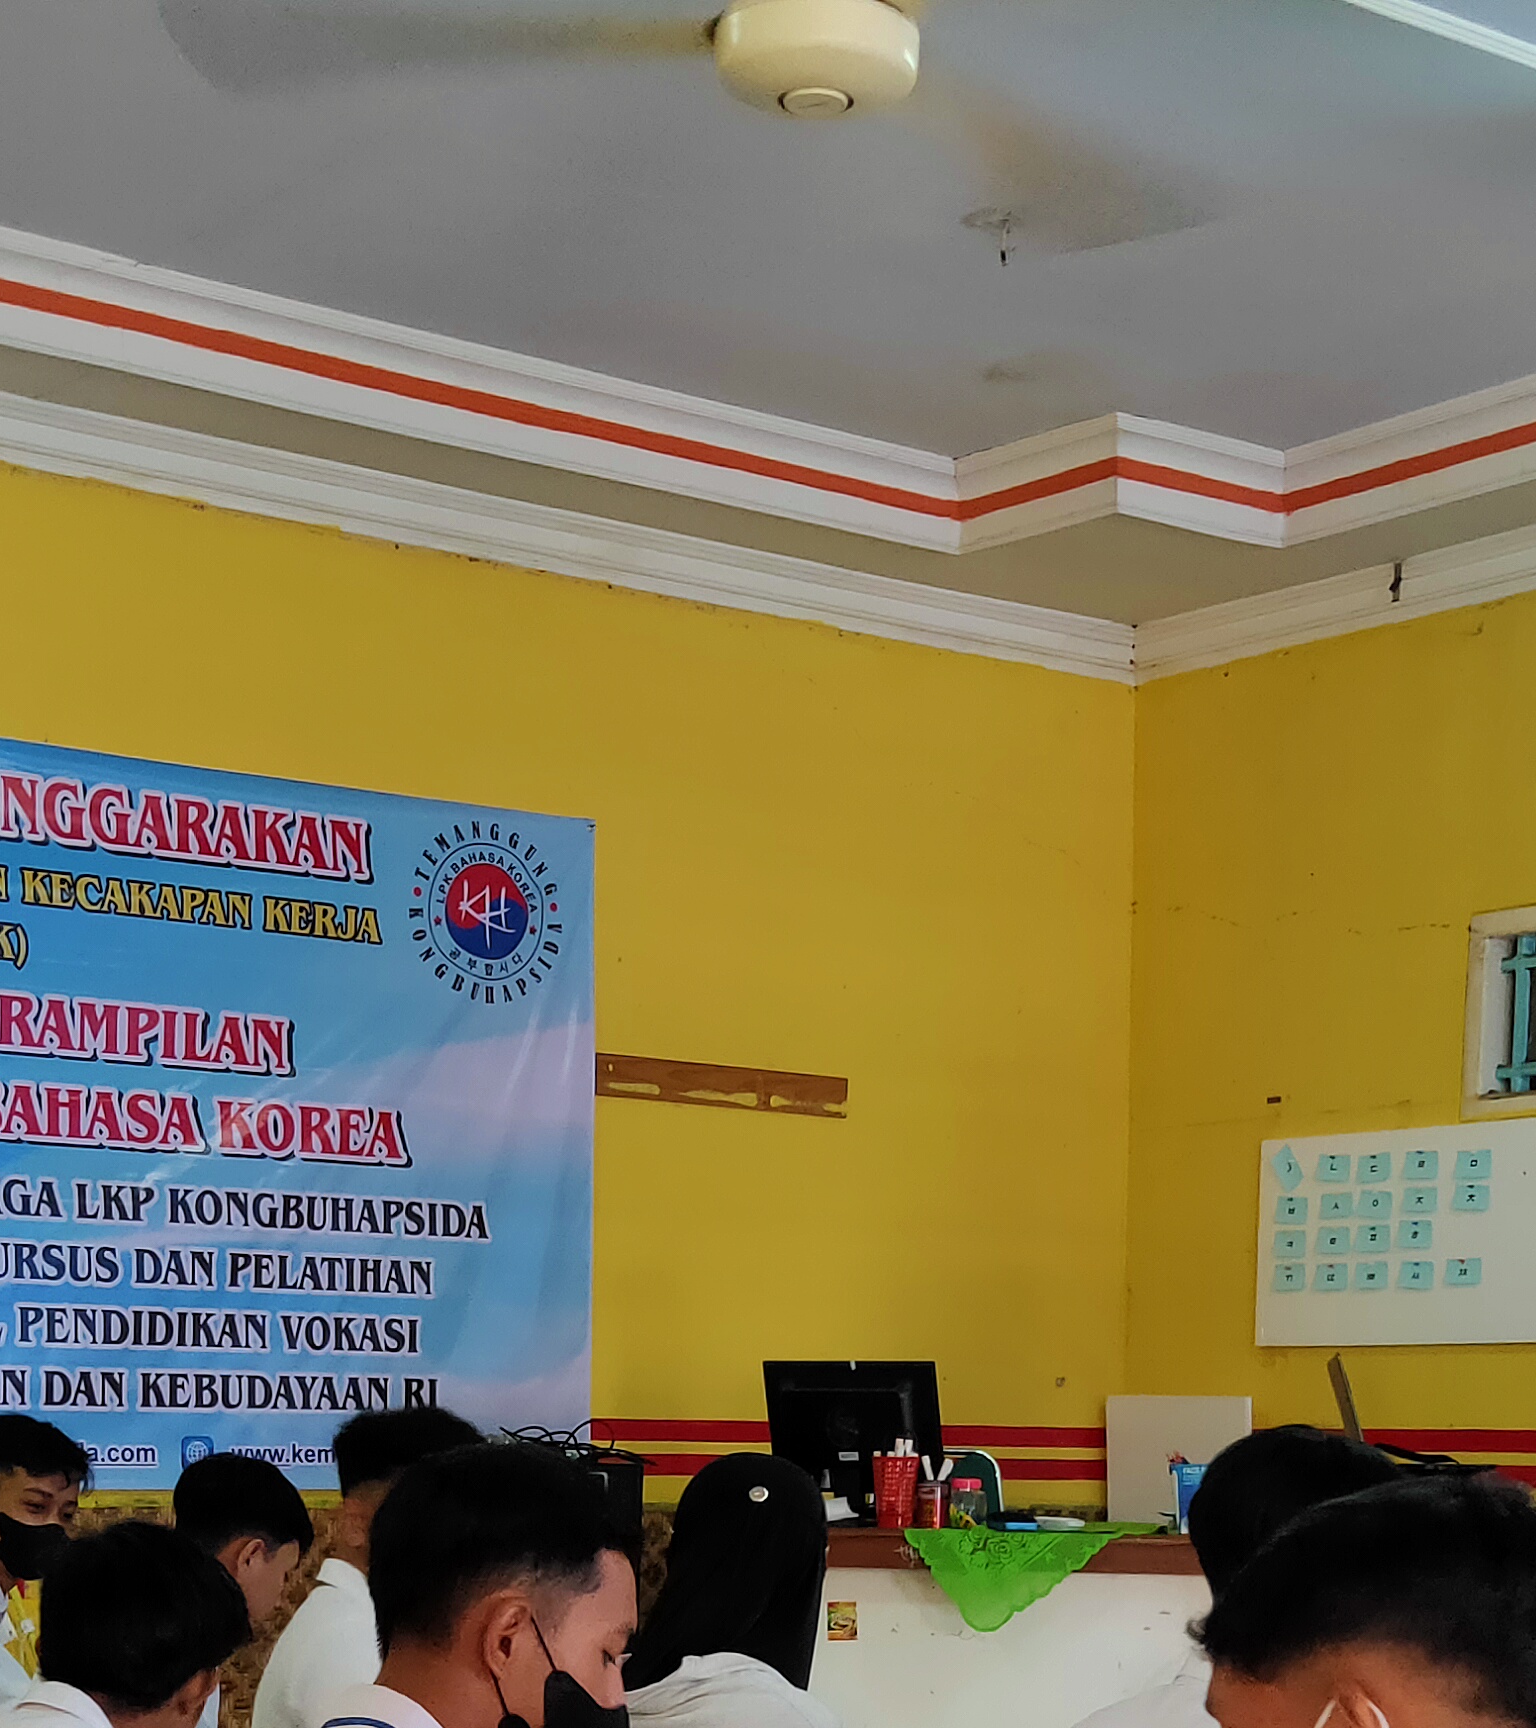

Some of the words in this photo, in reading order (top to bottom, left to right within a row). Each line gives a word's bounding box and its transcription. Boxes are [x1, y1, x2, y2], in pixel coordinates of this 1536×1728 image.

[414, 821, 557, 896] TEMANGGUNG
[436, 874, 453, 904] LPK
[450, 851, 505, 875] BAHASA
[506, 863, 538, 913] KOREA
[22, 870, 252, 928] KECAKAPAN
[264, 900, 382, 946] KERJA
[409, 907, 563, 1004] KONGBUHAPSIDA
[219, 1098, 406, 1166] KOREA
[74, 1184, 154, 1224] LKP
[169, 1189, 490, 1240] KONGBUHAPSIDA
[135, 1249, 216, 1289] DAN
[228, 1252, 434, 1296] PELATIHAN
[16, 1307, 266, 1350] PENDIDIKAN
[281, 1315, 420, 1354] VOKASI
[44, 1370, 125, 1407] DAN
[140, 1372, 389, 1411] KEBUDAYAAN
[404, 1377, 438, 1408] RI
[230, 1443, 336, 1465] www.kem
